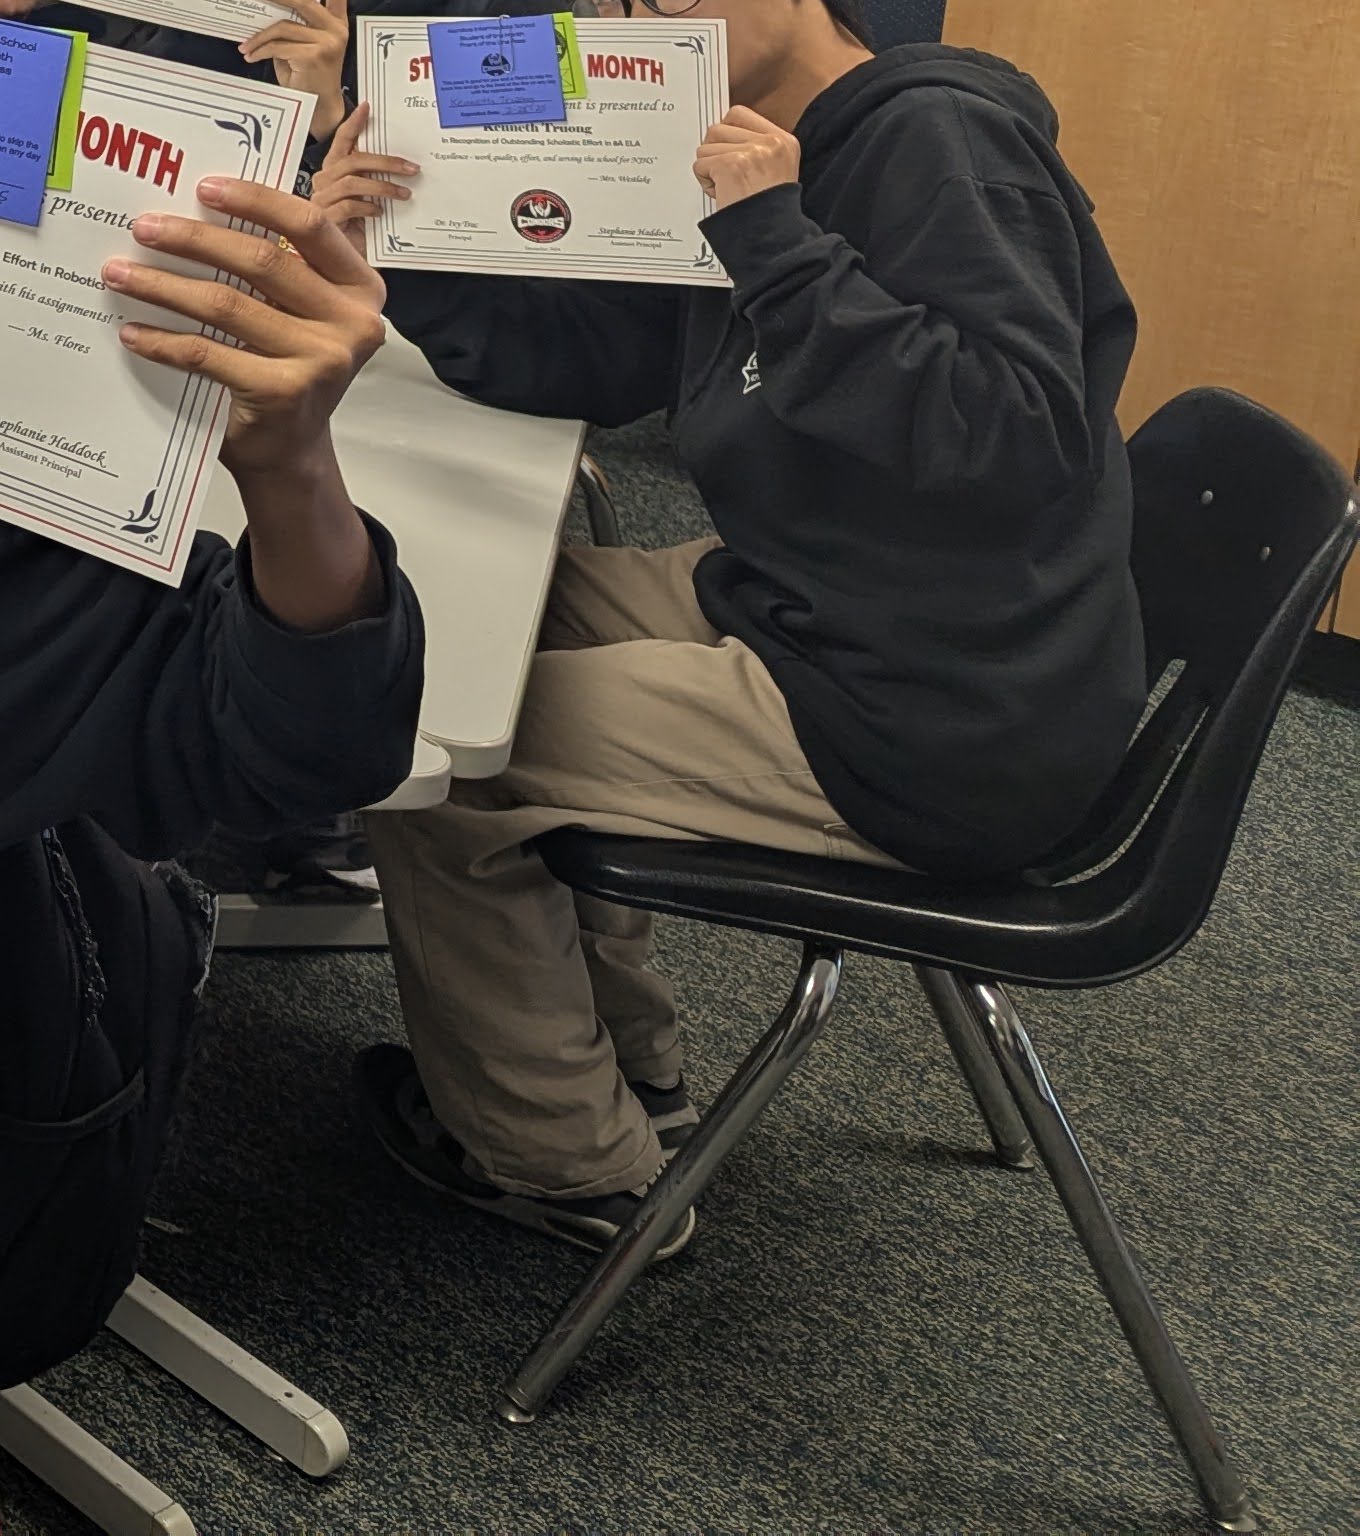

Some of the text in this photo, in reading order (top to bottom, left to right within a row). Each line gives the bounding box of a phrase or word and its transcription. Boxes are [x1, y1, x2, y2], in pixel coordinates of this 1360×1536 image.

[0, 36, 38, 52] School
[587, 53, 665, 86] MONTH
[404, 96, 429, 108] This
[586, 99, 675, 114] is presented to
[540, 122, 593, 135] Truong
[48, 194, 137, 232] presente
[3, 251, 37, 272] Effort
[40, 262, 51, 274] in
[54, 266, 107, 291] Robotics
[18, 285, 37, 302] his
[37, 293, 114, 325] assignments!
[27, 326, 92, 355] Ms. Flores
[48, 434, 108, 469] Haddock
[39, 455, 82, 479] Principal
